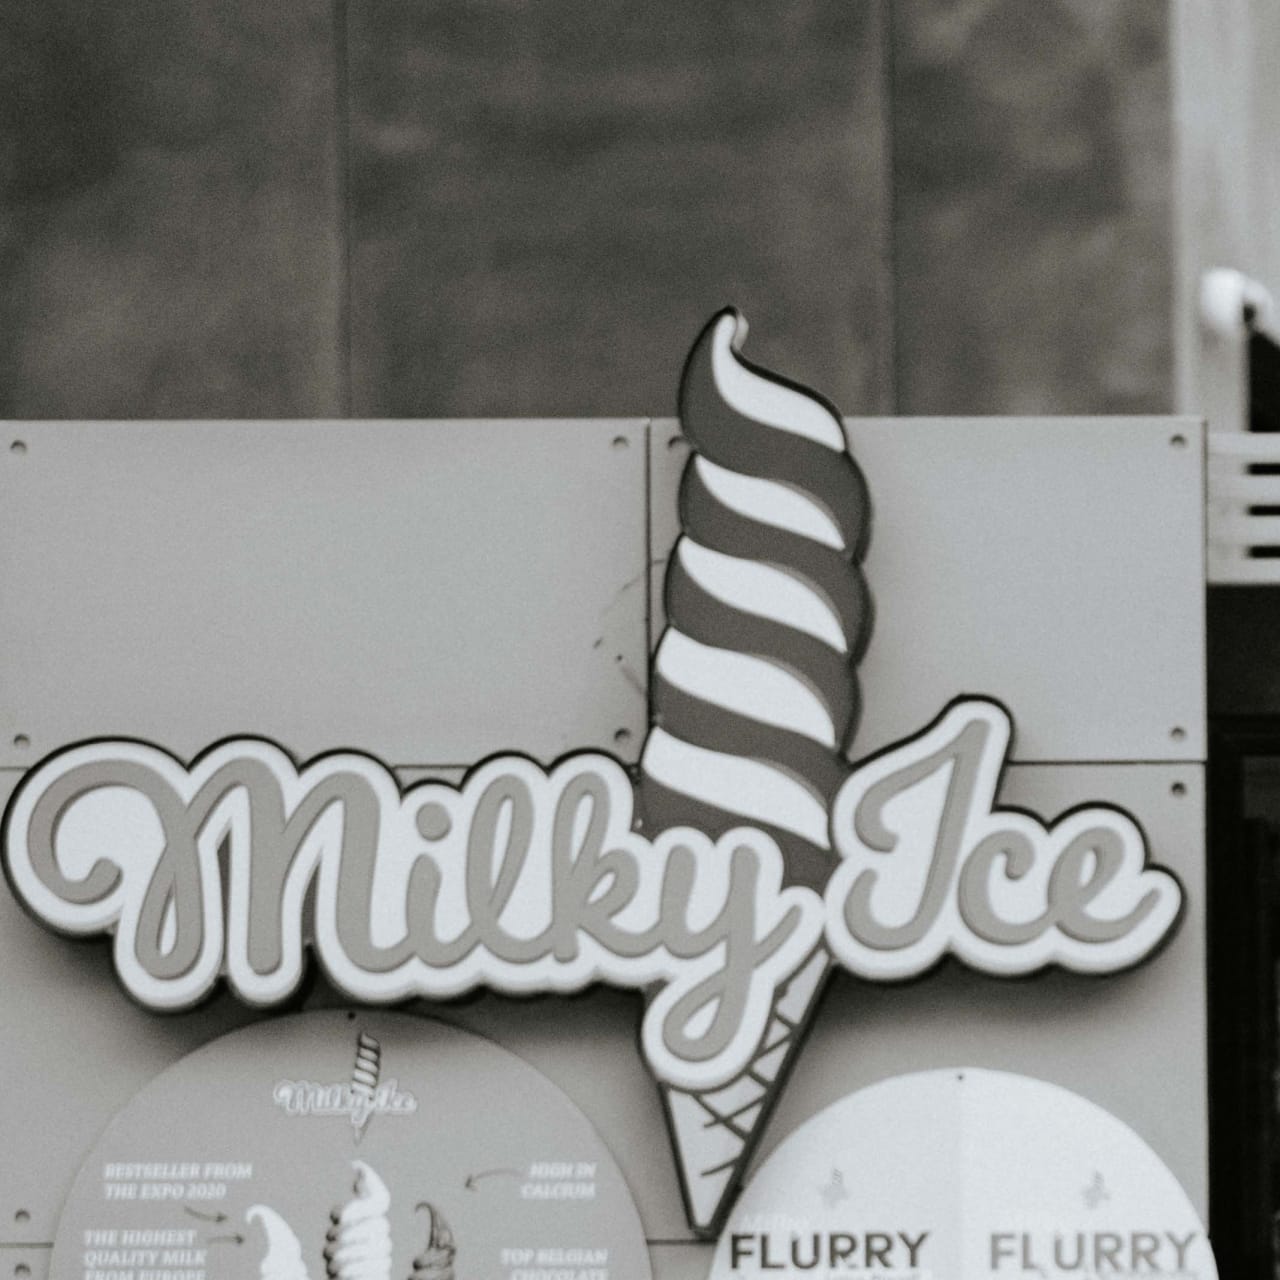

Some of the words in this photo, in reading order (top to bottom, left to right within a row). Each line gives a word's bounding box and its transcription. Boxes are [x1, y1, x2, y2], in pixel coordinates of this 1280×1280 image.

[22, 750, 808, 1064] Milky
[838, 714, 1164, 950] Ice
[203, 1163, 252, 1179] FROM
[529, 1162, 576, 1179] HIGH
[577, 1162, 597, 1179] IN
[106, 1182, 138, 1199] THE
[140, 1182, 186, 1199] EXPO
[521, 1181, 596, 1199] CALCIUM
[84, 1230, 118, 1246] THE
[121, 1230, 197, 1246] HIGHEST
[83, 1250, 160, 1268] QUALITY
[161, 1250, 207, 1266] MILK
[501, 1248, 535, 1264] TOP
[536, 1248, 608, 1264] BELGIAN
[731, 1232, 929, 1269] FLURRY
[990, 1232, 1196, 1270] FLURRY
